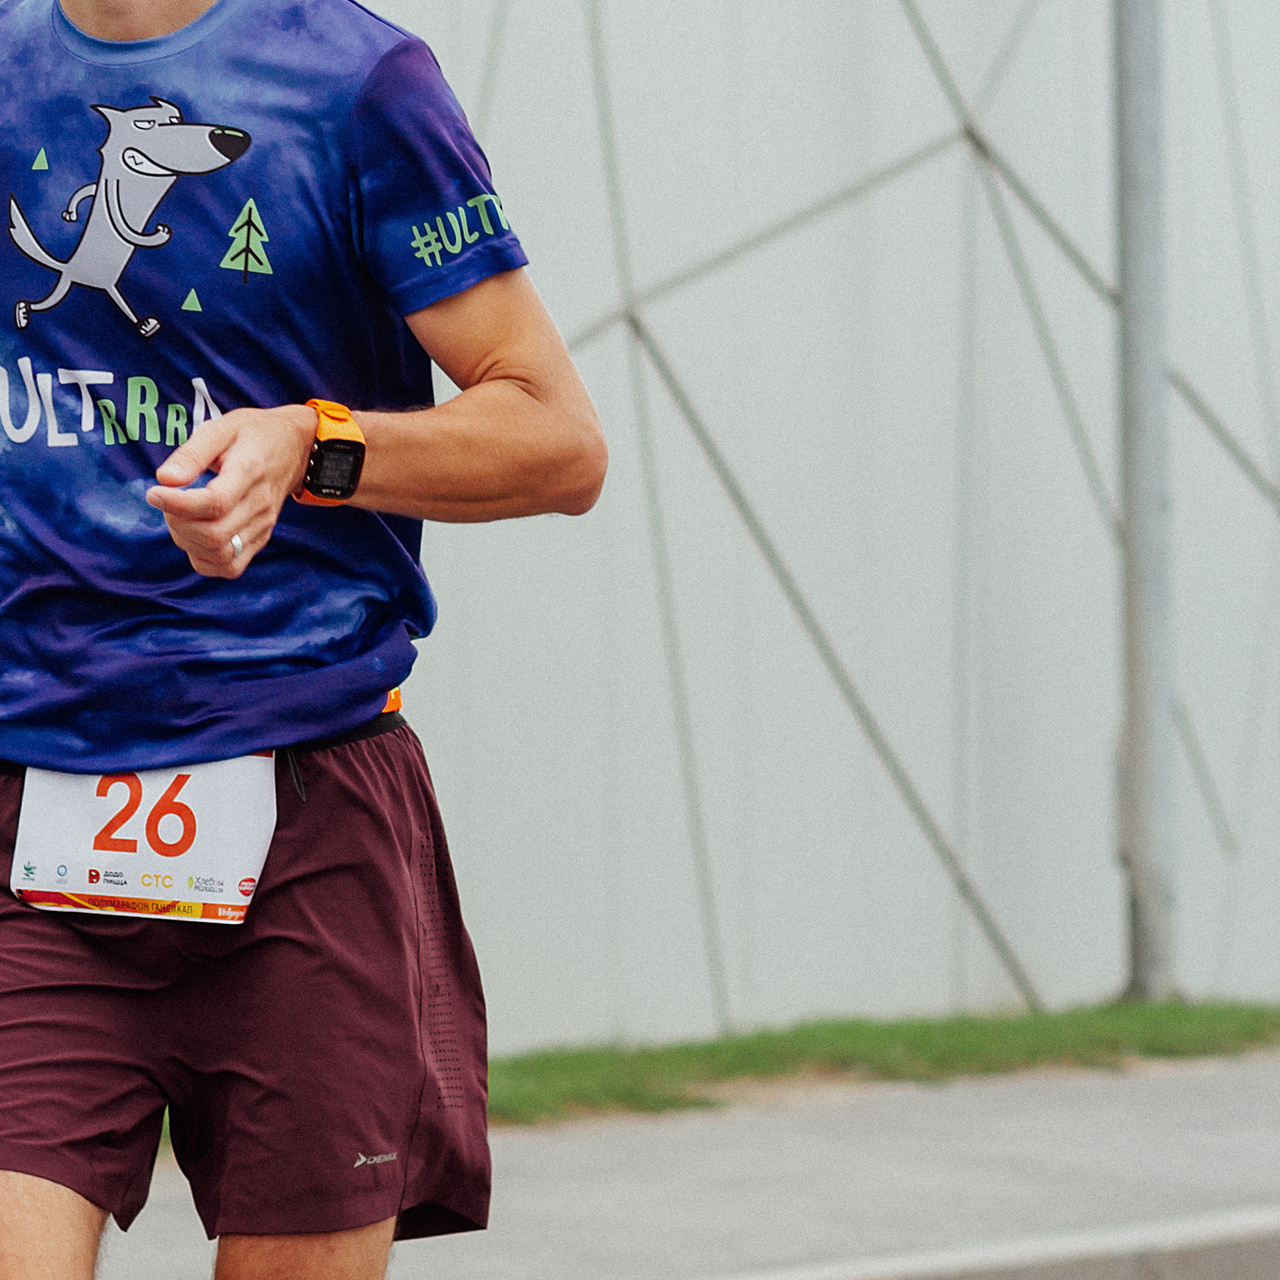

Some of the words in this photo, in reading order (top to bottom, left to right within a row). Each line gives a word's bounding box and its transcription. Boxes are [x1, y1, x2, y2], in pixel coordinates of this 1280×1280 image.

[92, 772, 197, 858] 26
[87, 897, 150, 912] ПОЛУМАРАФОН
[151, 902, 193, 915] ГАНДИКАП
